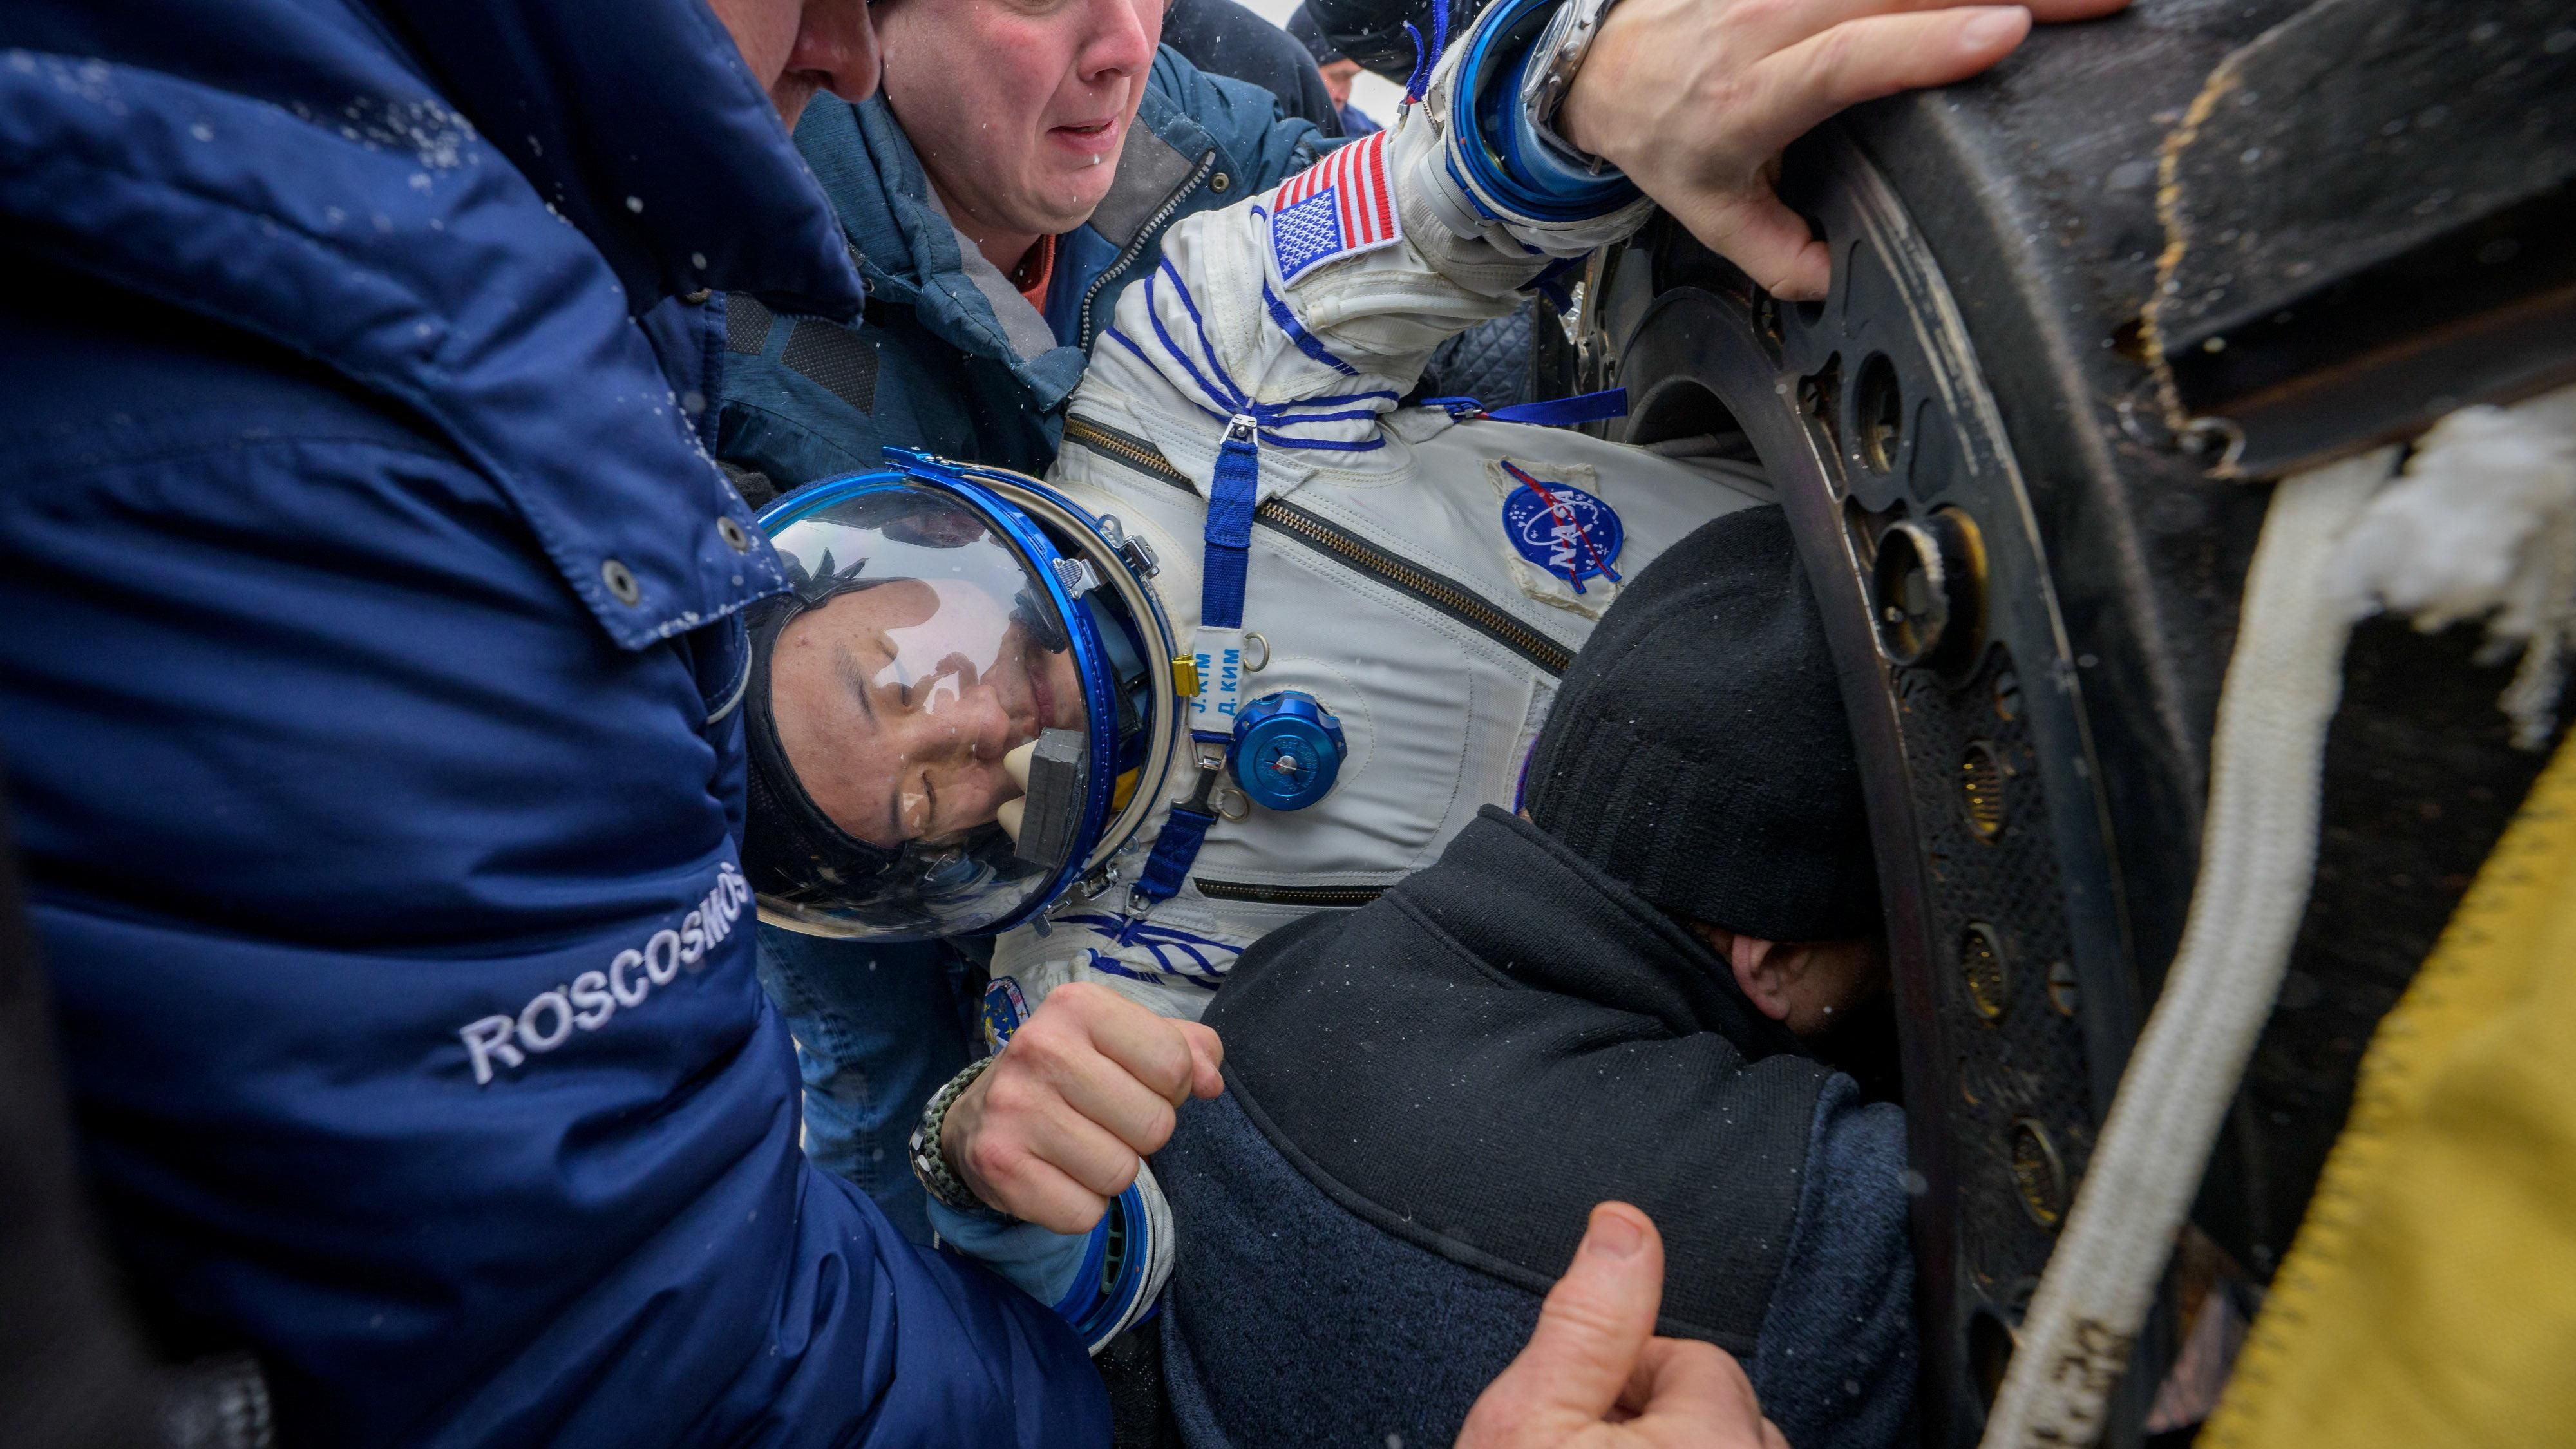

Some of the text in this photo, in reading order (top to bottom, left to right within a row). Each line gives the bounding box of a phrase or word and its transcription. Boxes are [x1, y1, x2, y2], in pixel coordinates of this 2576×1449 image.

[1549, 490, 1577, 571] NASA
[1220, 649, 1240, 692] КИМ
[459, 861, 748, 1085] ROSCOSMOS
